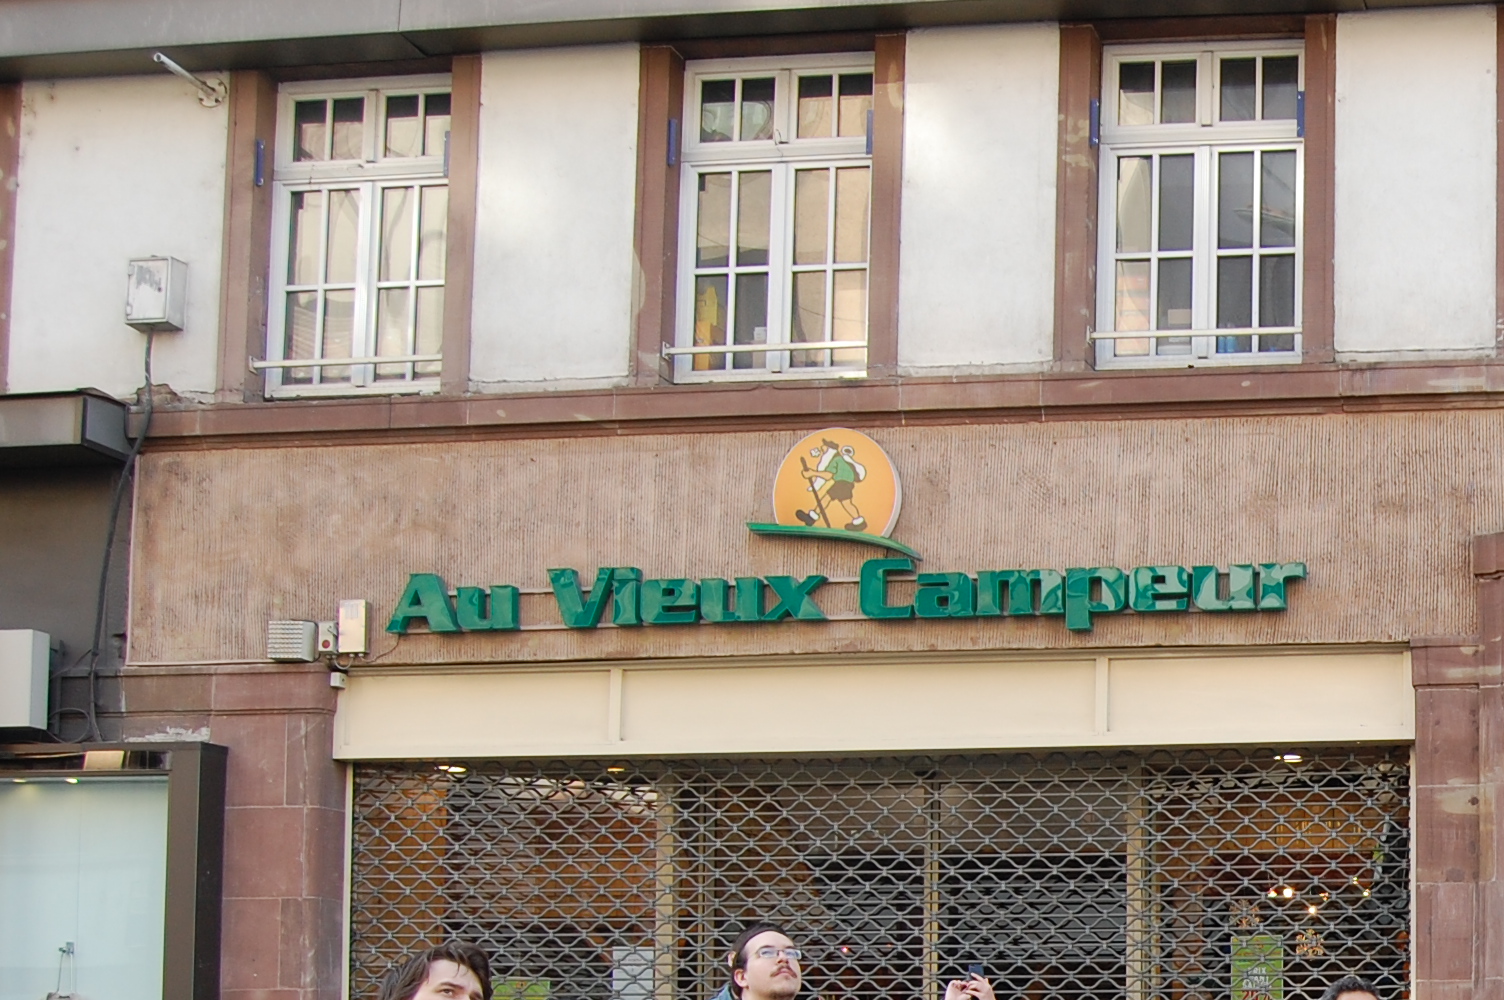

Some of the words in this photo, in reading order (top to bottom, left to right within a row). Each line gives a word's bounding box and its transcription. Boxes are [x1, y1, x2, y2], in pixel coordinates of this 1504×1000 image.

[386, 572, 520, 634] Au
[547, 565, 829, 629] Vieux
[859, 557, 1307, 632] Campeur
